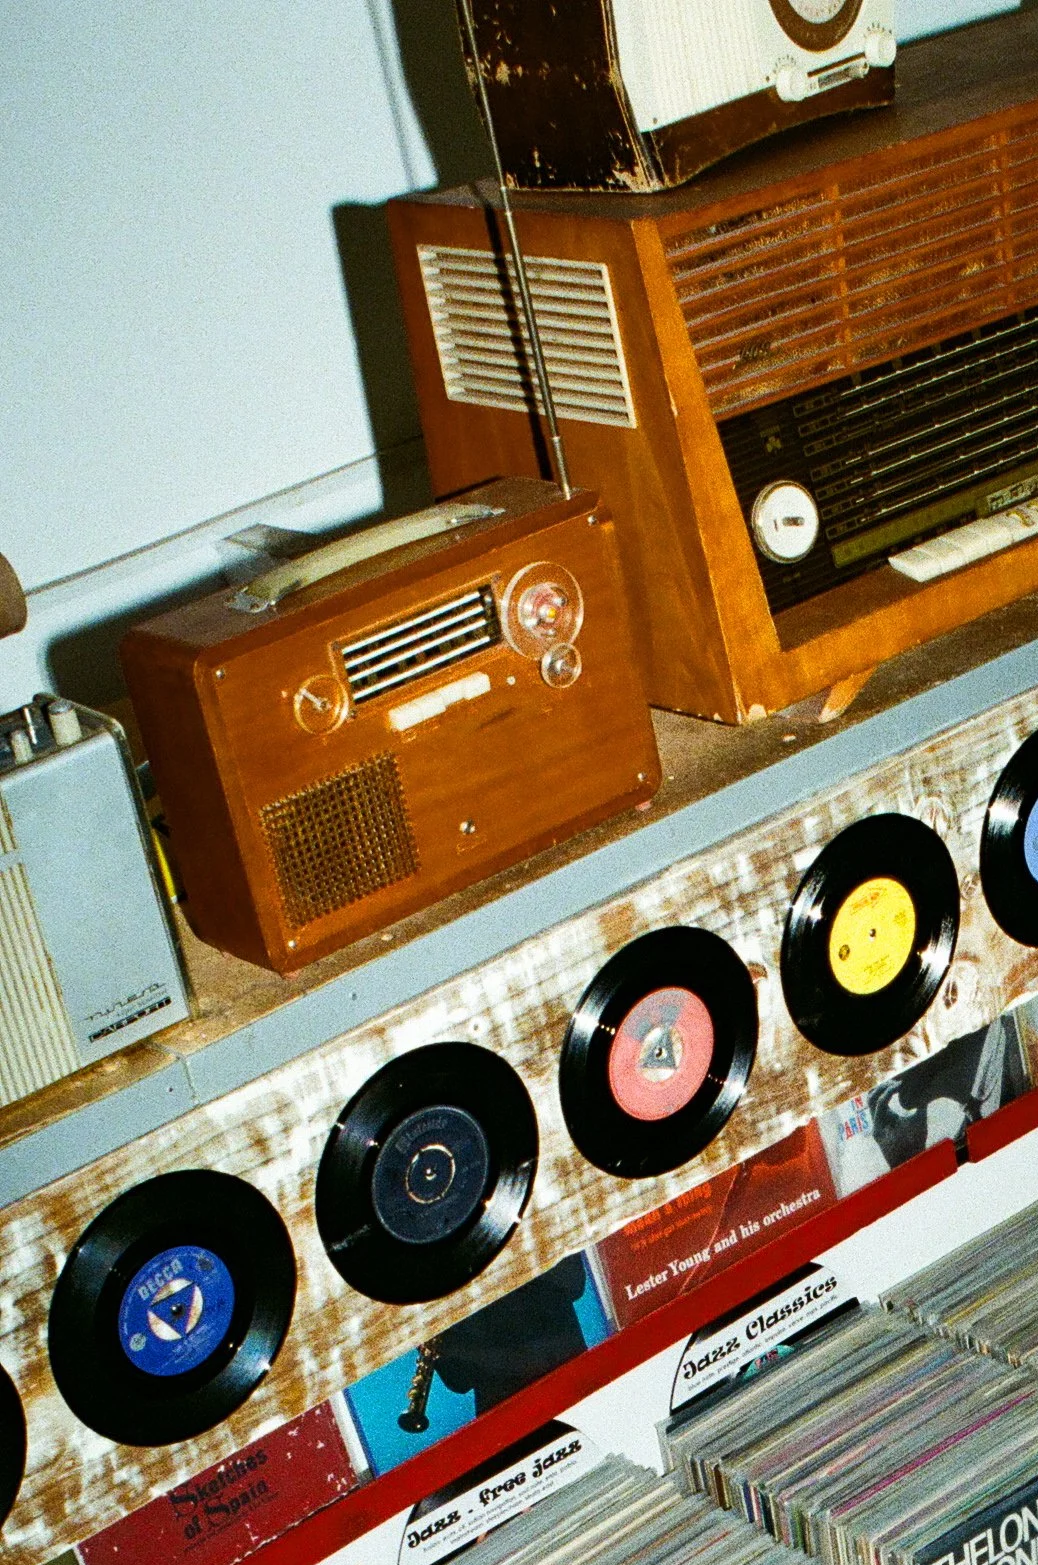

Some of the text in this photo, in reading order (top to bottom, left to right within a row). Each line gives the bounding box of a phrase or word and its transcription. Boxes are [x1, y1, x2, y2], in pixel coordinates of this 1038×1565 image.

[838, 1112, 869, 1141] PARIS
[136, 1258, 184, 1301] DECCA
[624, 1270, 668, 1300] Lester
[668, 1247, 711, 1278] Young
[713, 1230, 738, 1254] and
[740, 1220, 760, 1239] his
[762, 1188, 821, 1226] orchestra
[683, 1276, 838, 1380] Jazz Classics
[168, 1449, 267, 1521] Sketches
[184, 1515, 201, 1539] of
[203, 1480, 267, 1527] Spain
[407, 1509, 461, 1549] Jazz
[478, 1471, 526, 1507] free
[532, 1439, 582, 1478] jazz
